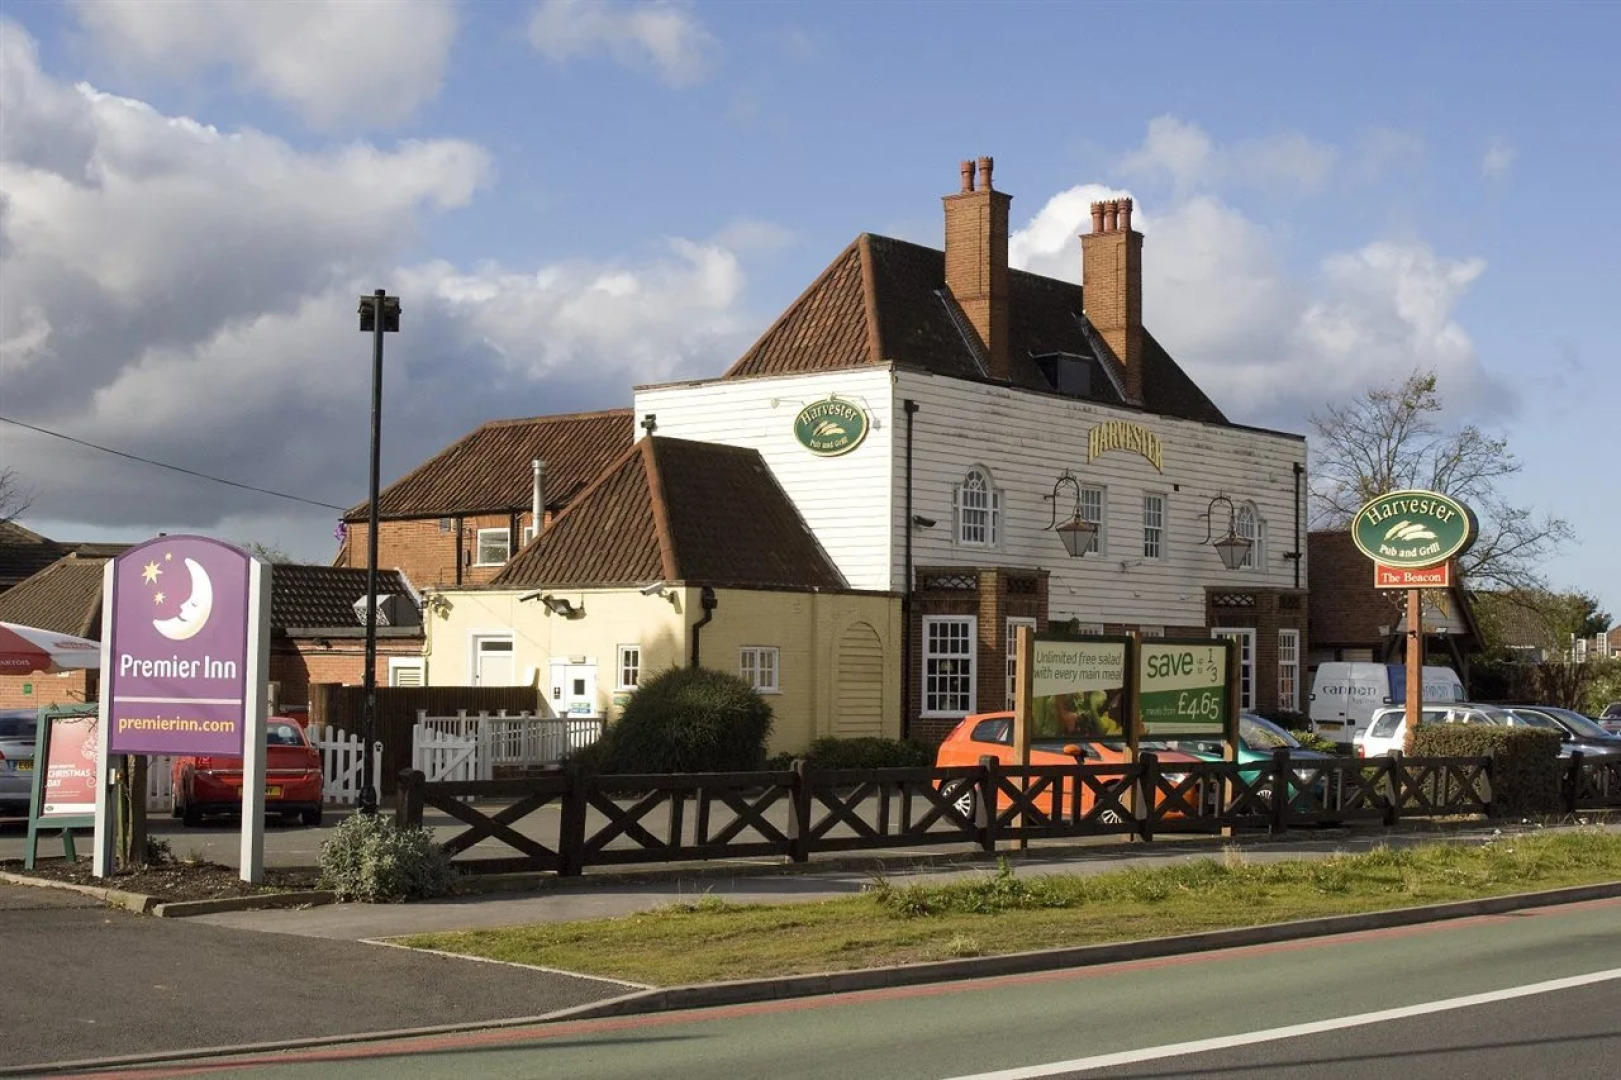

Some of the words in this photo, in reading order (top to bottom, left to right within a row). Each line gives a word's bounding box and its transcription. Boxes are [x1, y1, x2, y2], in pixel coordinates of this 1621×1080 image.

[801, 404, 857, 425] Harvester
[1087, 420, 1164, 475] HARVESTER
[1365, 499, 1455, 526] Harvester
[1379, 544, 1398, 557] Pub
[1399, 547, 1418, 558] and
[1419, 542, 1440, 555] Grill
[1382, 573, 1400, 583] The
[1404, 571, 1441, 583] Beacon
[120, 654, 201, 678] Premier
[204, 655, 237, 679] Inn
[1036, 651, 1077, 665] Unlimited
[1078, 652, 1097, 666] free
[1098, 653, 1122, 666] salad
[1147, 652, 1194, 679] save
[1033, 667, 1053, 680] with
[1054, 669, 1078, 683] every
[1079, 667, 1100, 680] main
[1101, 668, 1123, 680] meal
[1178, 692, 1219, 720] £4.65
[118, 715, 235, 733] premierinn.com
[48, 769, 91, 778] CHRISTMAS
[47, 779, 62, 787] DAY
